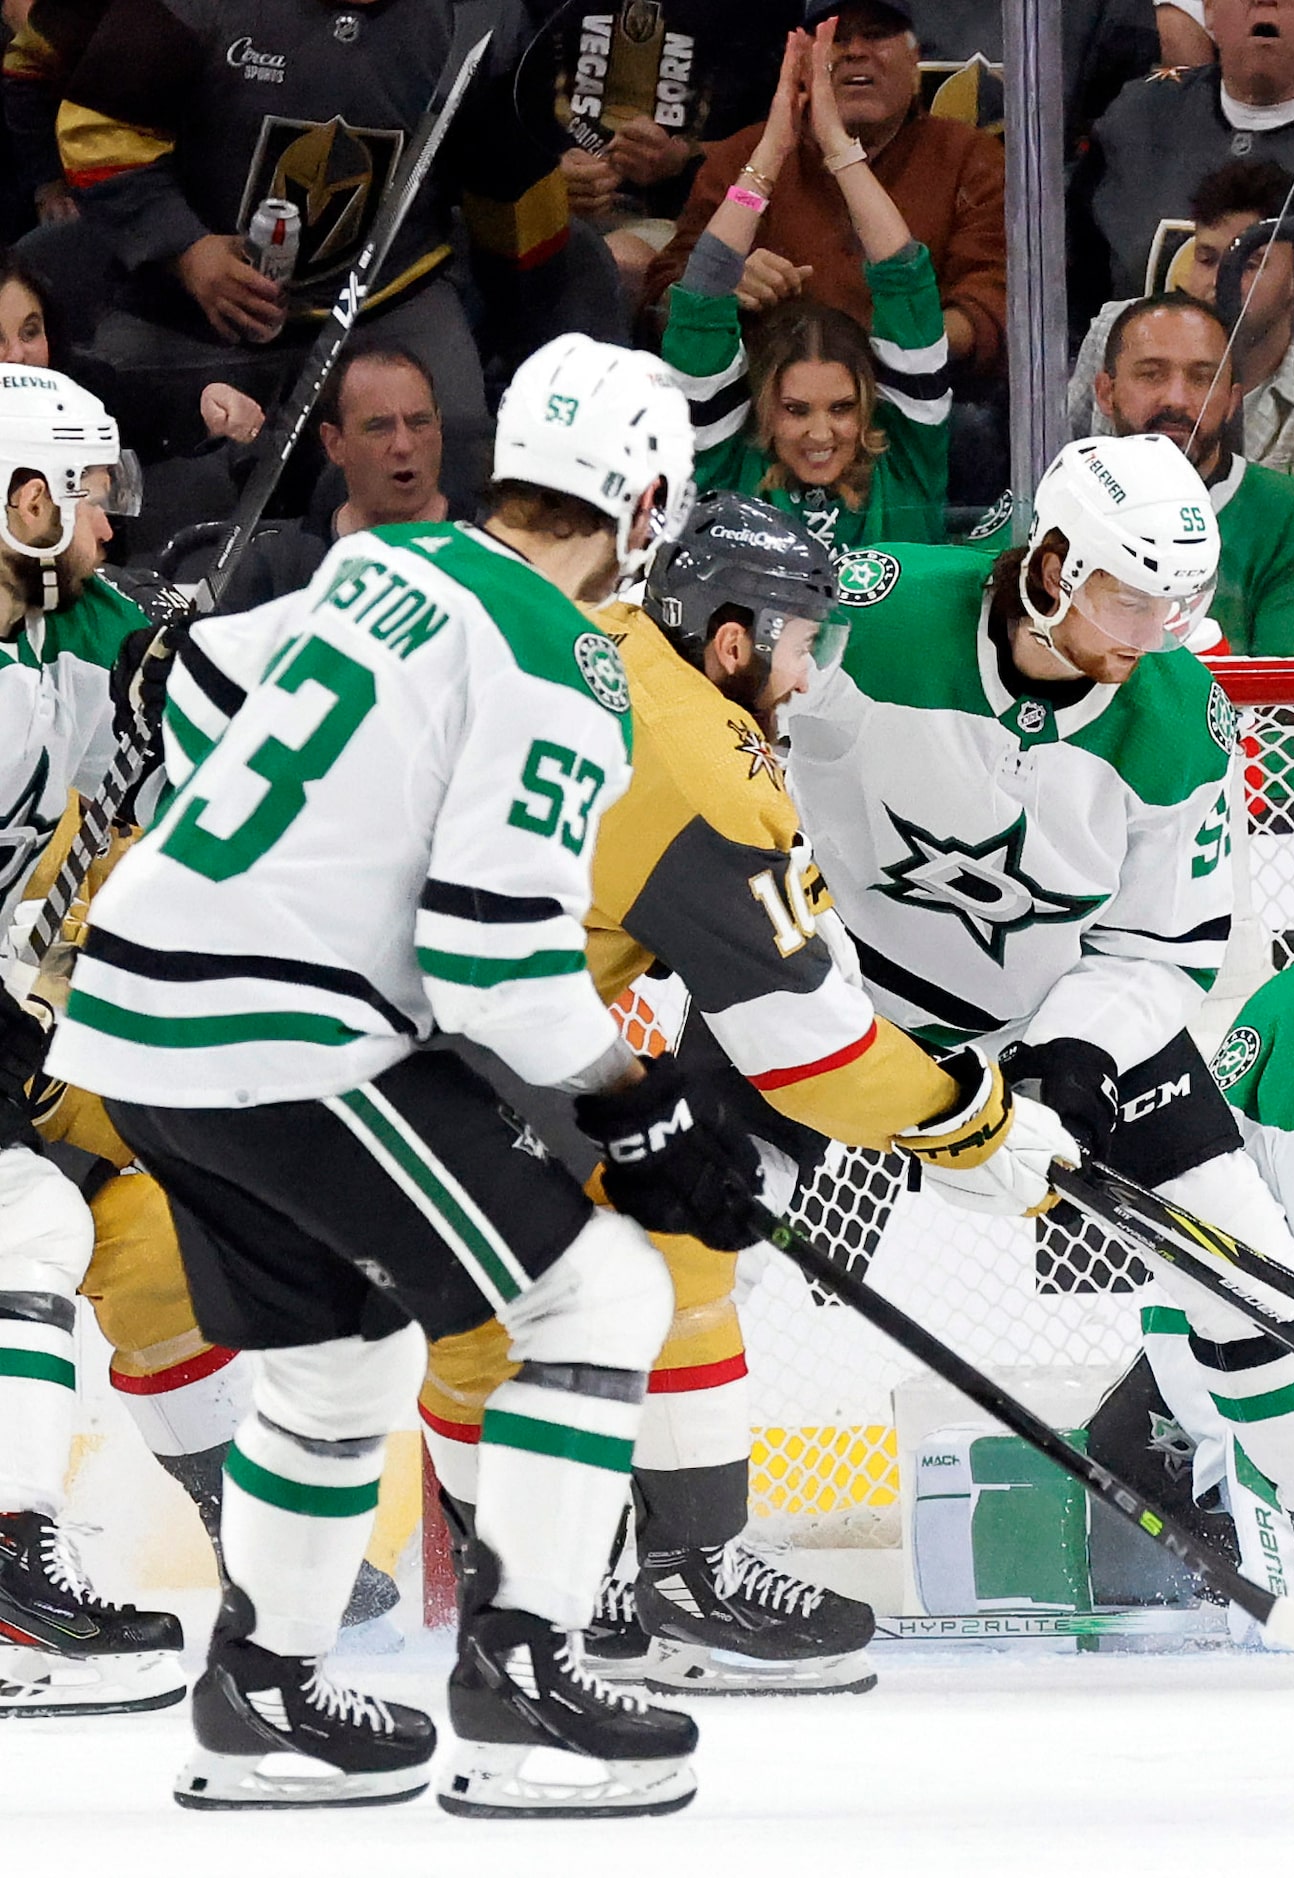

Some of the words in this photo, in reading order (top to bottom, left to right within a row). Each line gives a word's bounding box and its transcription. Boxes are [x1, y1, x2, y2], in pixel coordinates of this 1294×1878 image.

[227, 36, 287, 67] Circa
[570, 14, 614, 118] VEGAS
[655, 31, 695, 127] BORN
[544, 394, 579, 426] 53
[1180, 507, 1206, 532] 55
[506, 738, 606, 858] 53
